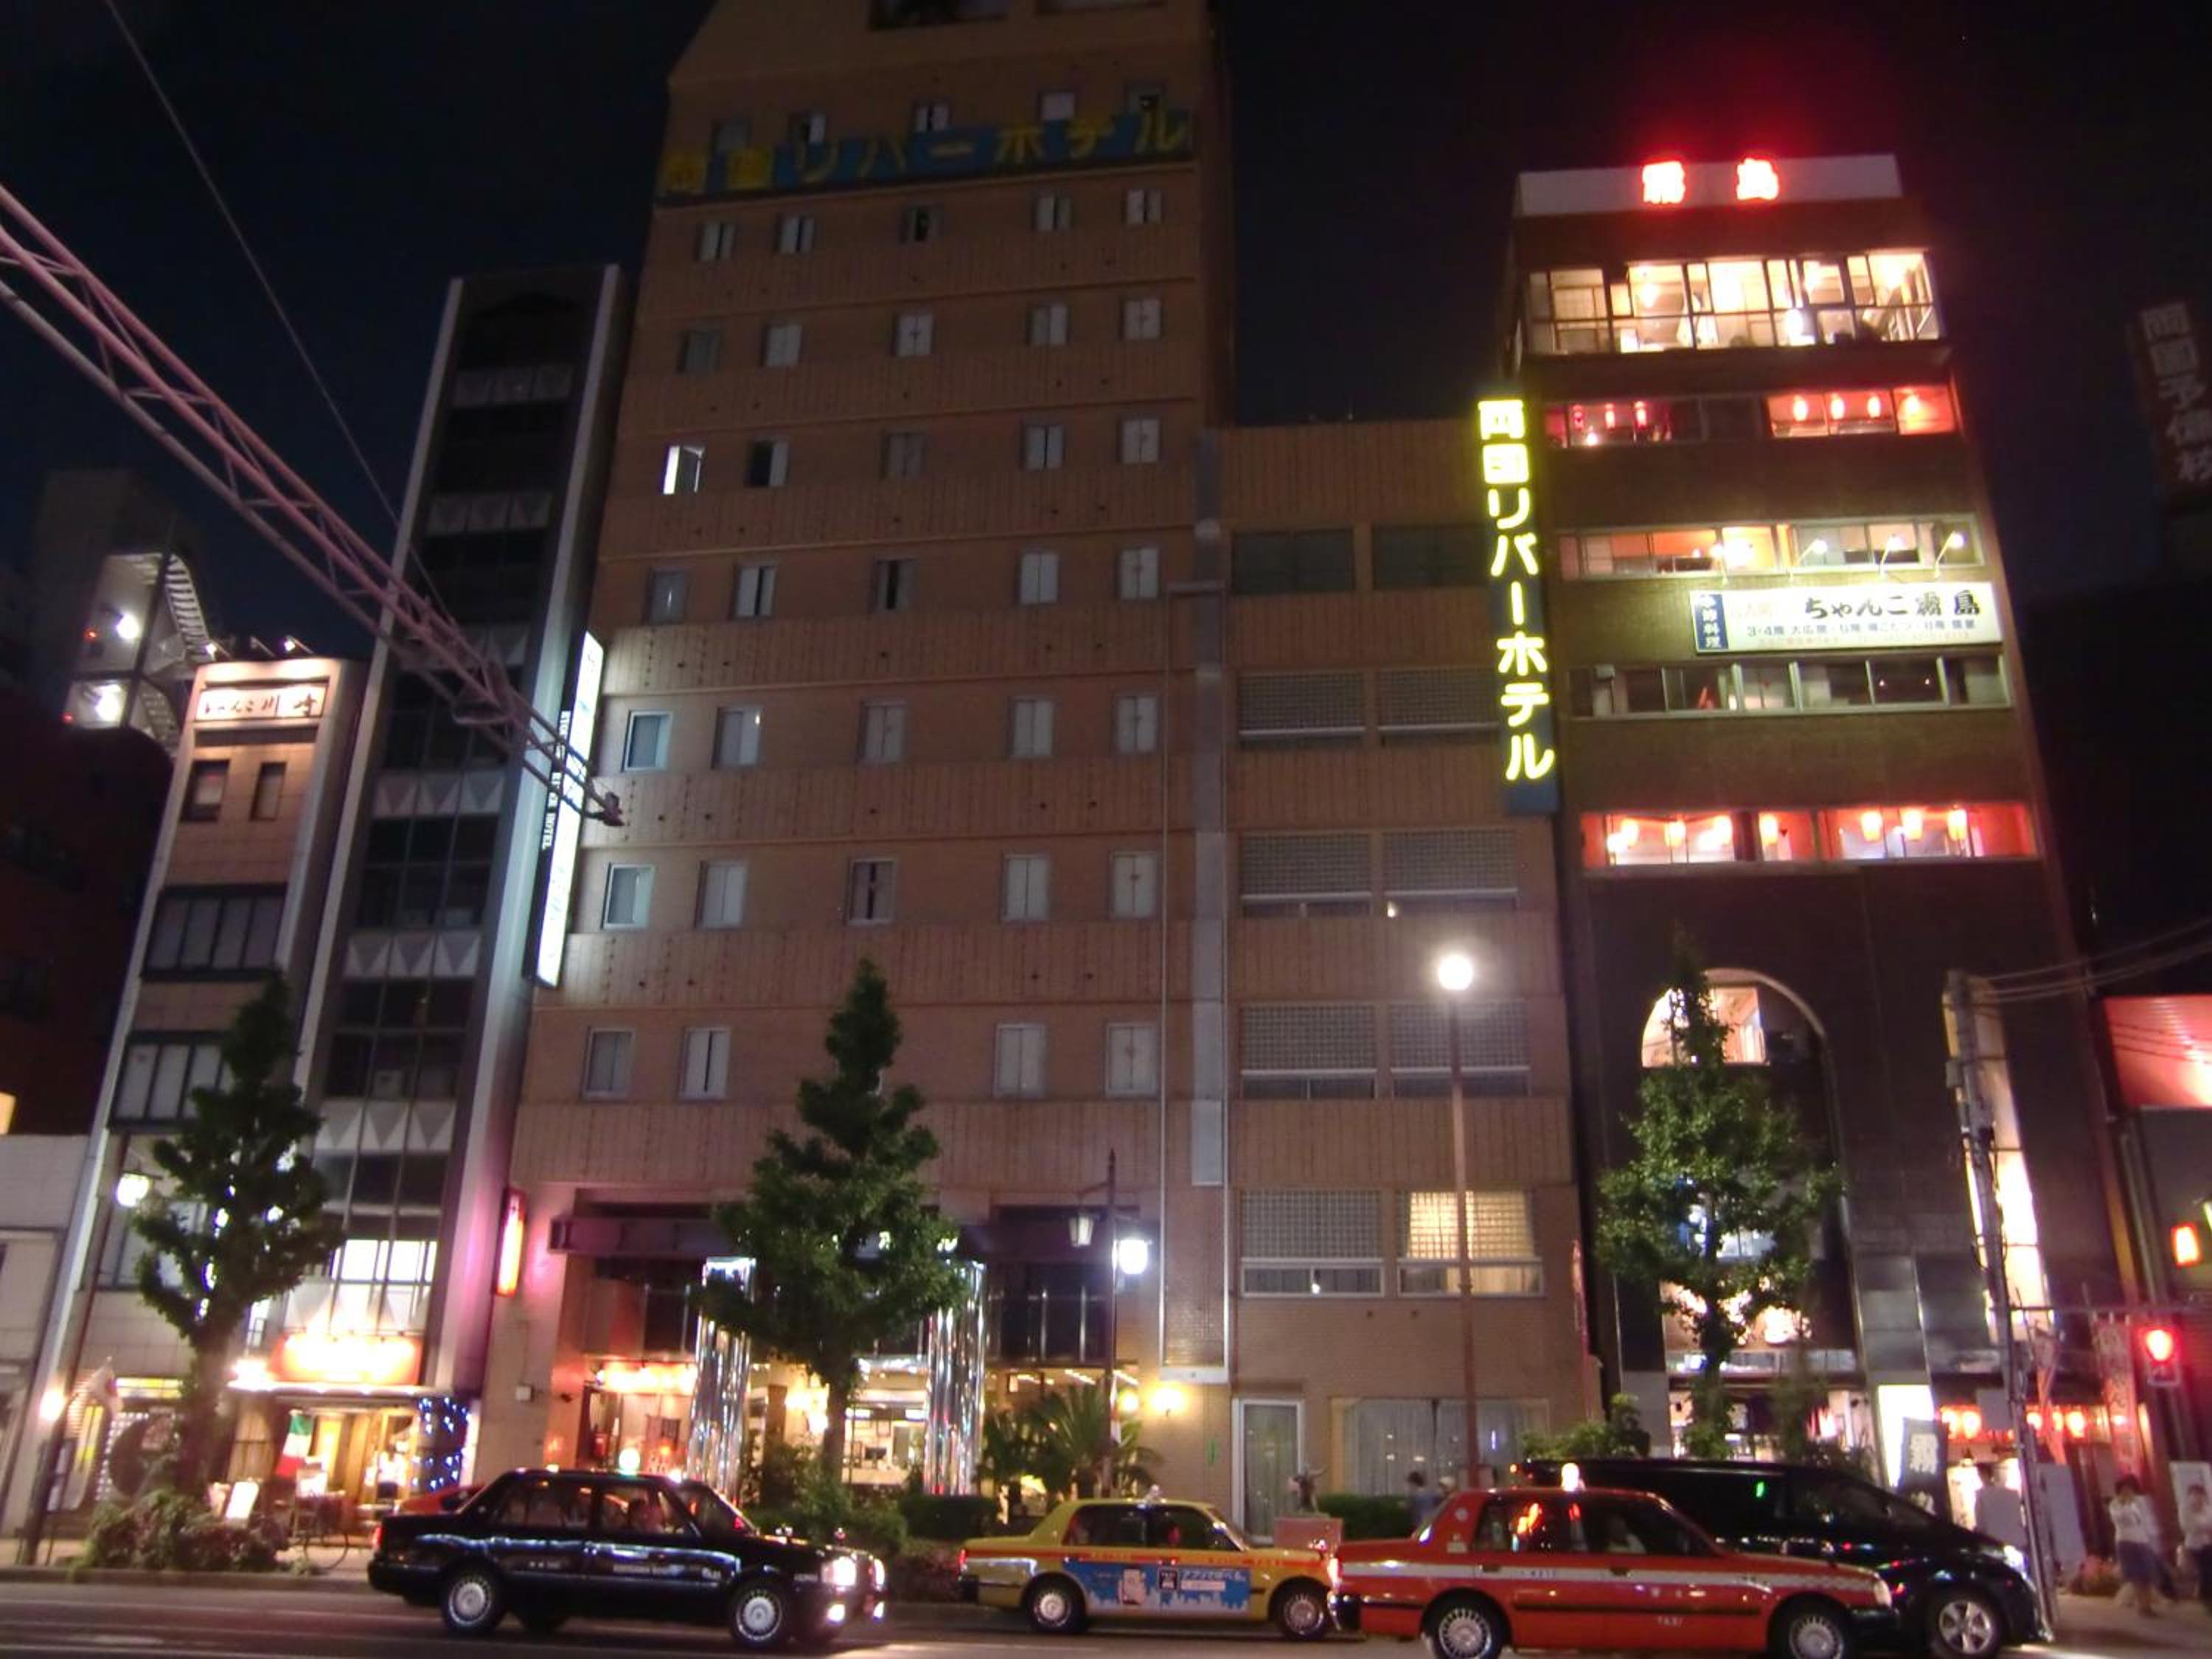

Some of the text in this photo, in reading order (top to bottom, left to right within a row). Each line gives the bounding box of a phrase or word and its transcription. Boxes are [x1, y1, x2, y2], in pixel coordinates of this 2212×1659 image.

[1478, 399, 1554, 782] 両国リバーホテル
